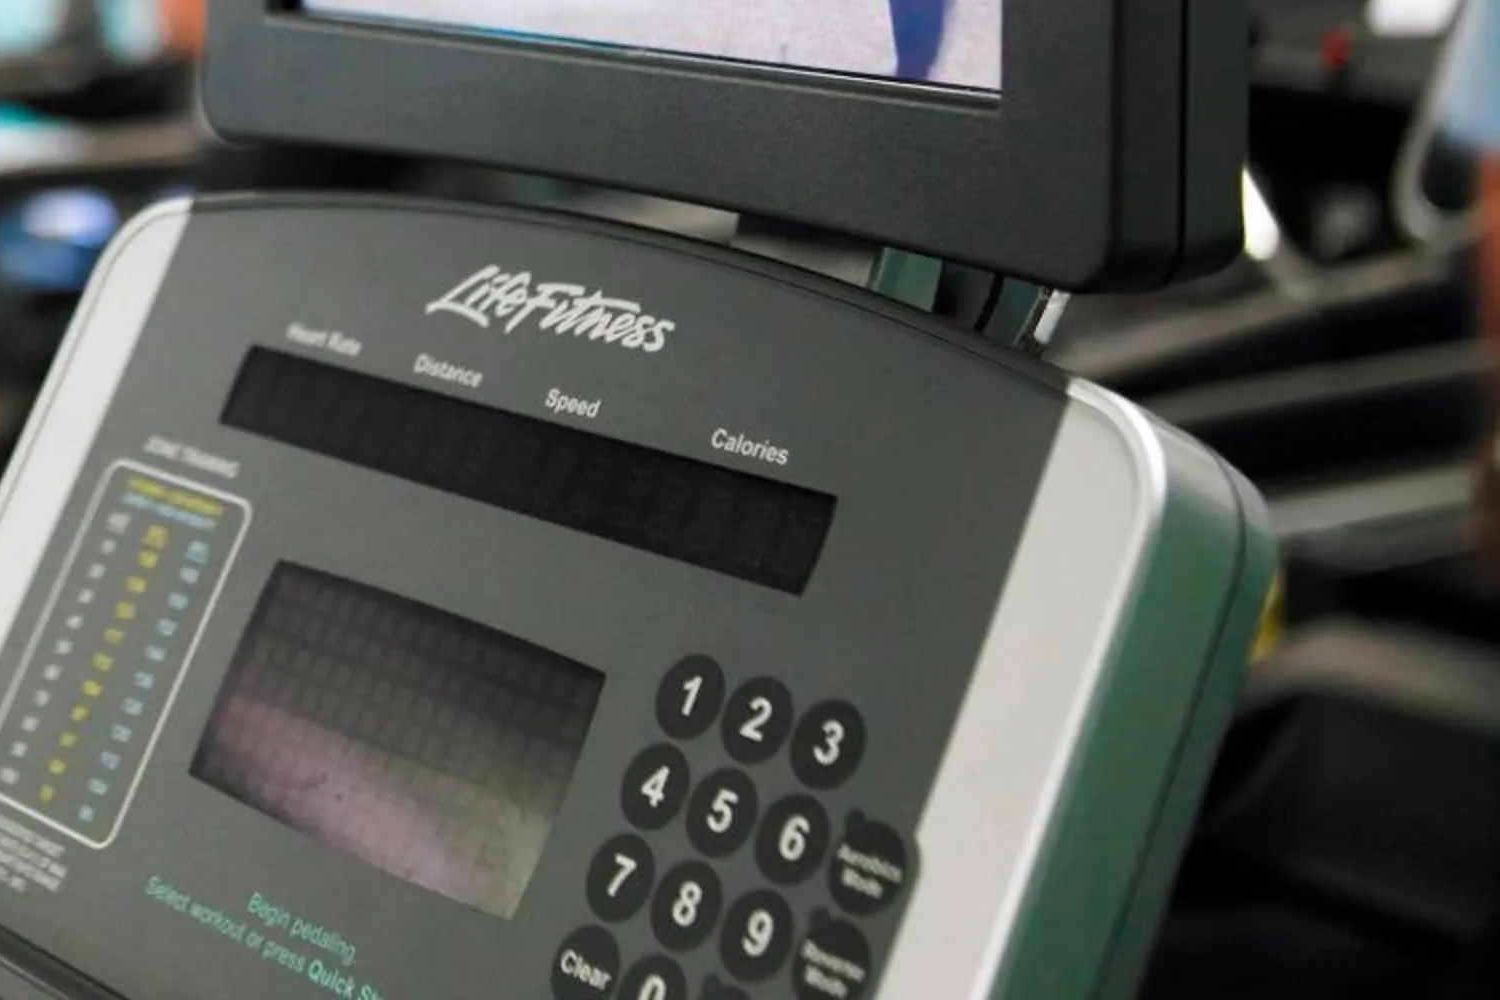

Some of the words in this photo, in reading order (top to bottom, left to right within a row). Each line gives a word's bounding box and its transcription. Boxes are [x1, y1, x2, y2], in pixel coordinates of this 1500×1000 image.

[413, 353, 484, 389] Distance
[545, 388, 601, 419] Speed
[710, 427, 790, 466] Calories
[682, 674, 704, 717] 1
[739, 697, 773, 743] 2
[812, 719, 846, 766] 3
[640, 764, 672, 809] 4
[706, 788, 740, 834] 5
[778, 815, 812, 862] 6
[606, 852, 638, 898] 7
[247, 890, 292, 932] Begin
[671, 880, 703, 928] 8
[144, 874, 191, 914] Select
[189, 900, 248, 943] workout
[245, 931, 265, 951] or
[262, 939, 306, 974] press
[307, 958, 356, 1000] Quick
[741, 909, 775, 958] 9
[560, 948, 612, 991] Clear
